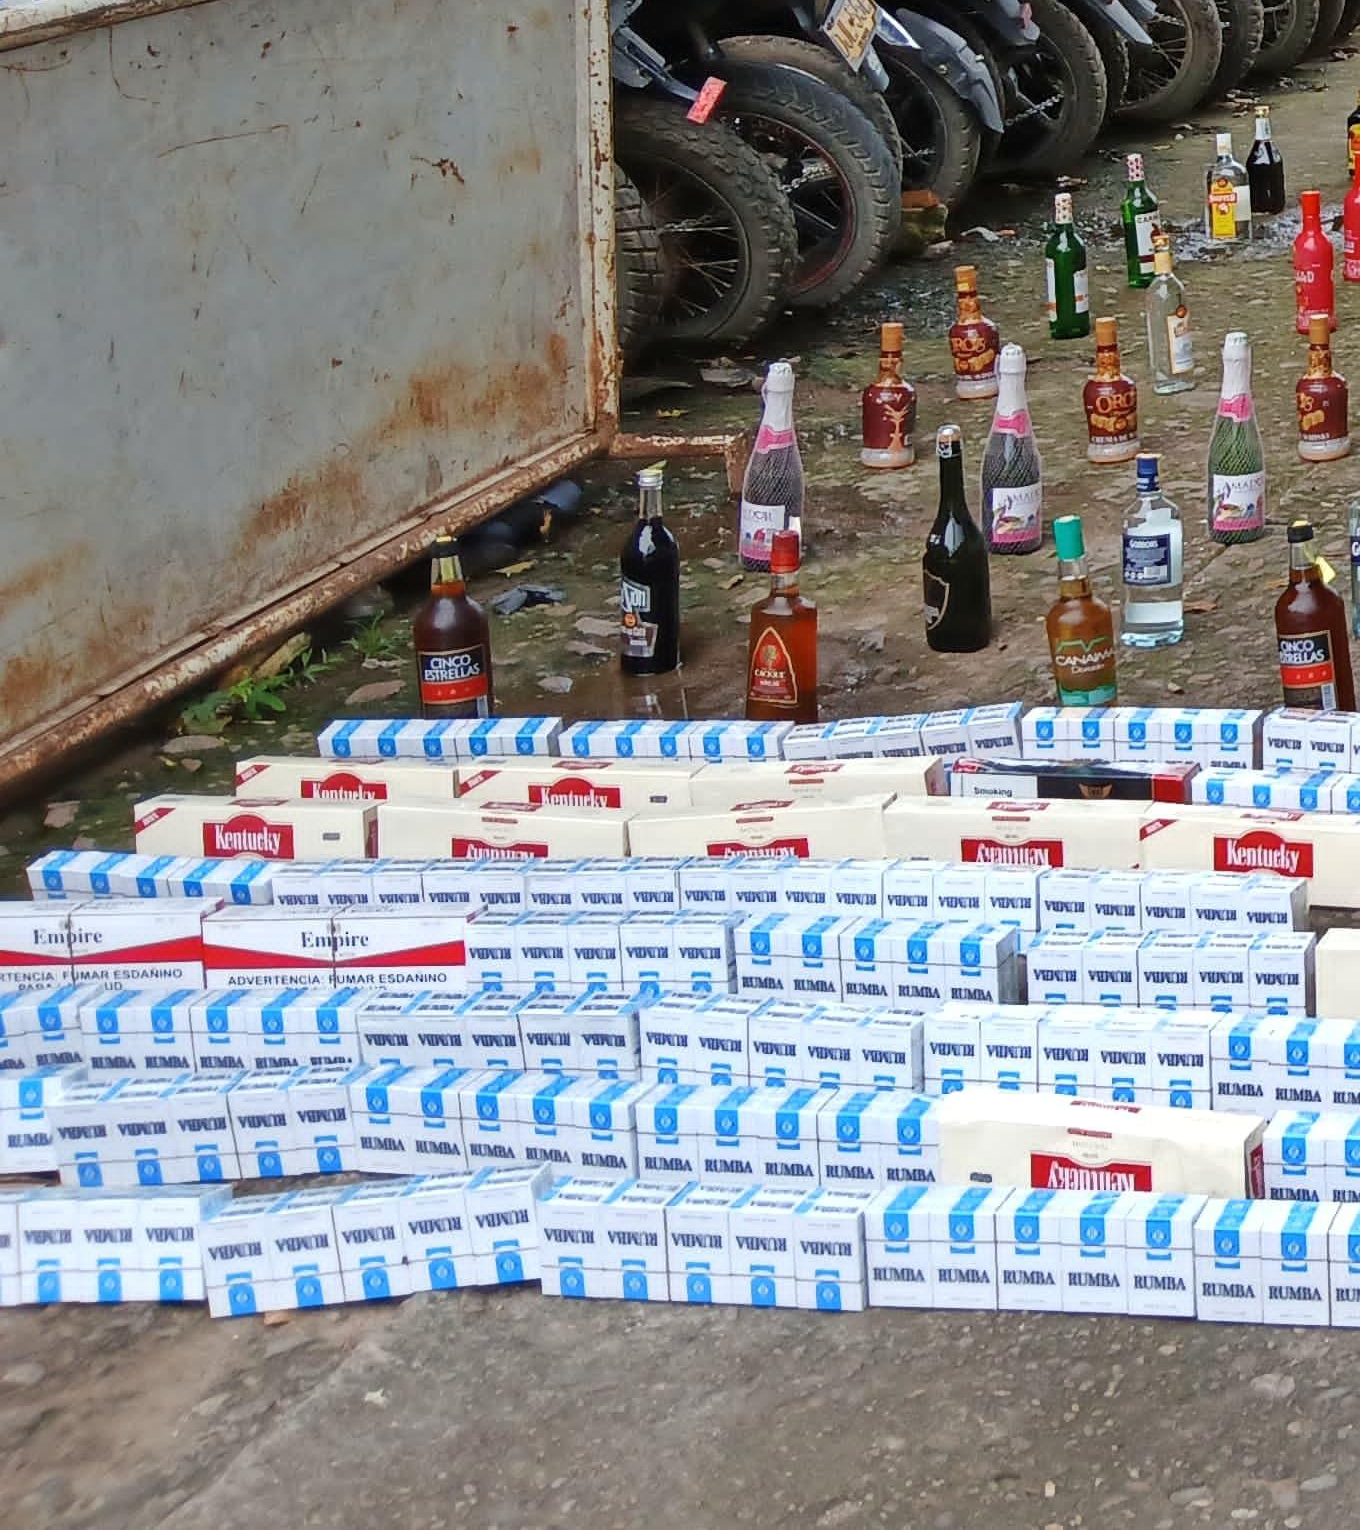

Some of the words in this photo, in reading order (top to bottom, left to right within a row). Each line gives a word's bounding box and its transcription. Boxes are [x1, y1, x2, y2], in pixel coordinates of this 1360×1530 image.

[430, 654, 471, 669] CINCO
[424, 662, 480, 681] ESTRELLAS
[214, 822, 281, 855] Kentucky
[1226, 838, 1300, 873] Kentucky
[33, 930, 103, 947] Empire
[300, 931, 369, 951] Empire
[62, 970, 109, 981] FUMAR
[227, 974, 325, 986] ADVERTENCIA:
[328, 973, 374, 985] FUMAR
[899, 985, 940, 998] RUMBA
[365, 1034, 408, 1046] RUMBA
[754, 1042, 796, 1056] RUMBA
[91, 1057, 135, 1068] RUMBA
[1101, 1051, 1145, 1064] RUMBA
[1048, 1160, 1136, 1191] Kentucky
[476, 1210, 528, 1227] RUMBA
[147, 1228, 193, 1241] RUMBA
[544, 1229, 594, 1243] RUMBA
[1135, 1276, 1185, 1290] RUMBA
